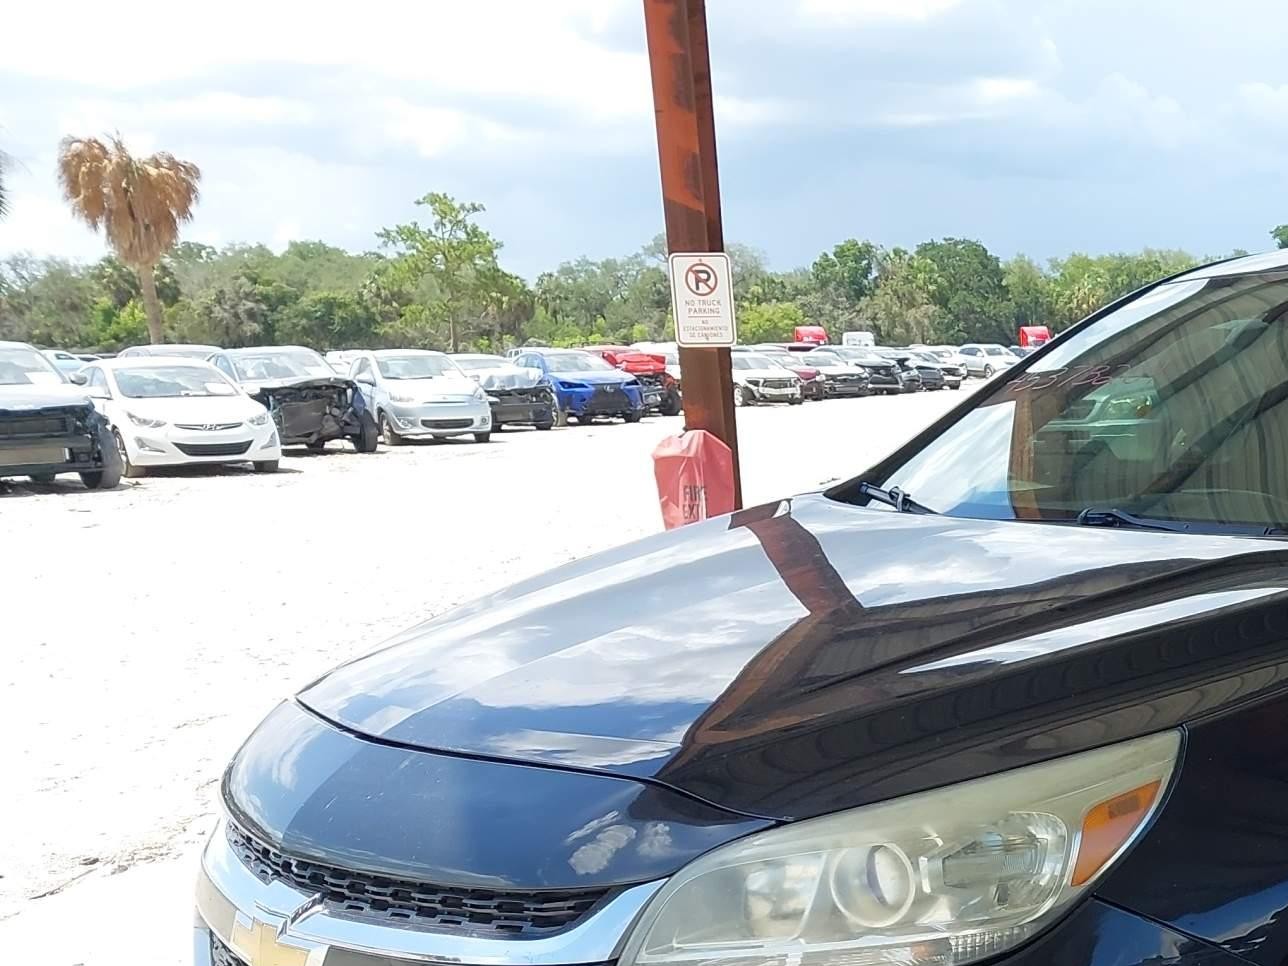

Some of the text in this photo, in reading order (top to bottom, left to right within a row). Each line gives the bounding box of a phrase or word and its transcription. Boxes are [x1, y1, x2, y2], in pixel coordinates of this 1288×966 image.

[684, 299, 722, 307] NO TRUCK
[687, 307, 720, 315] PARKING
